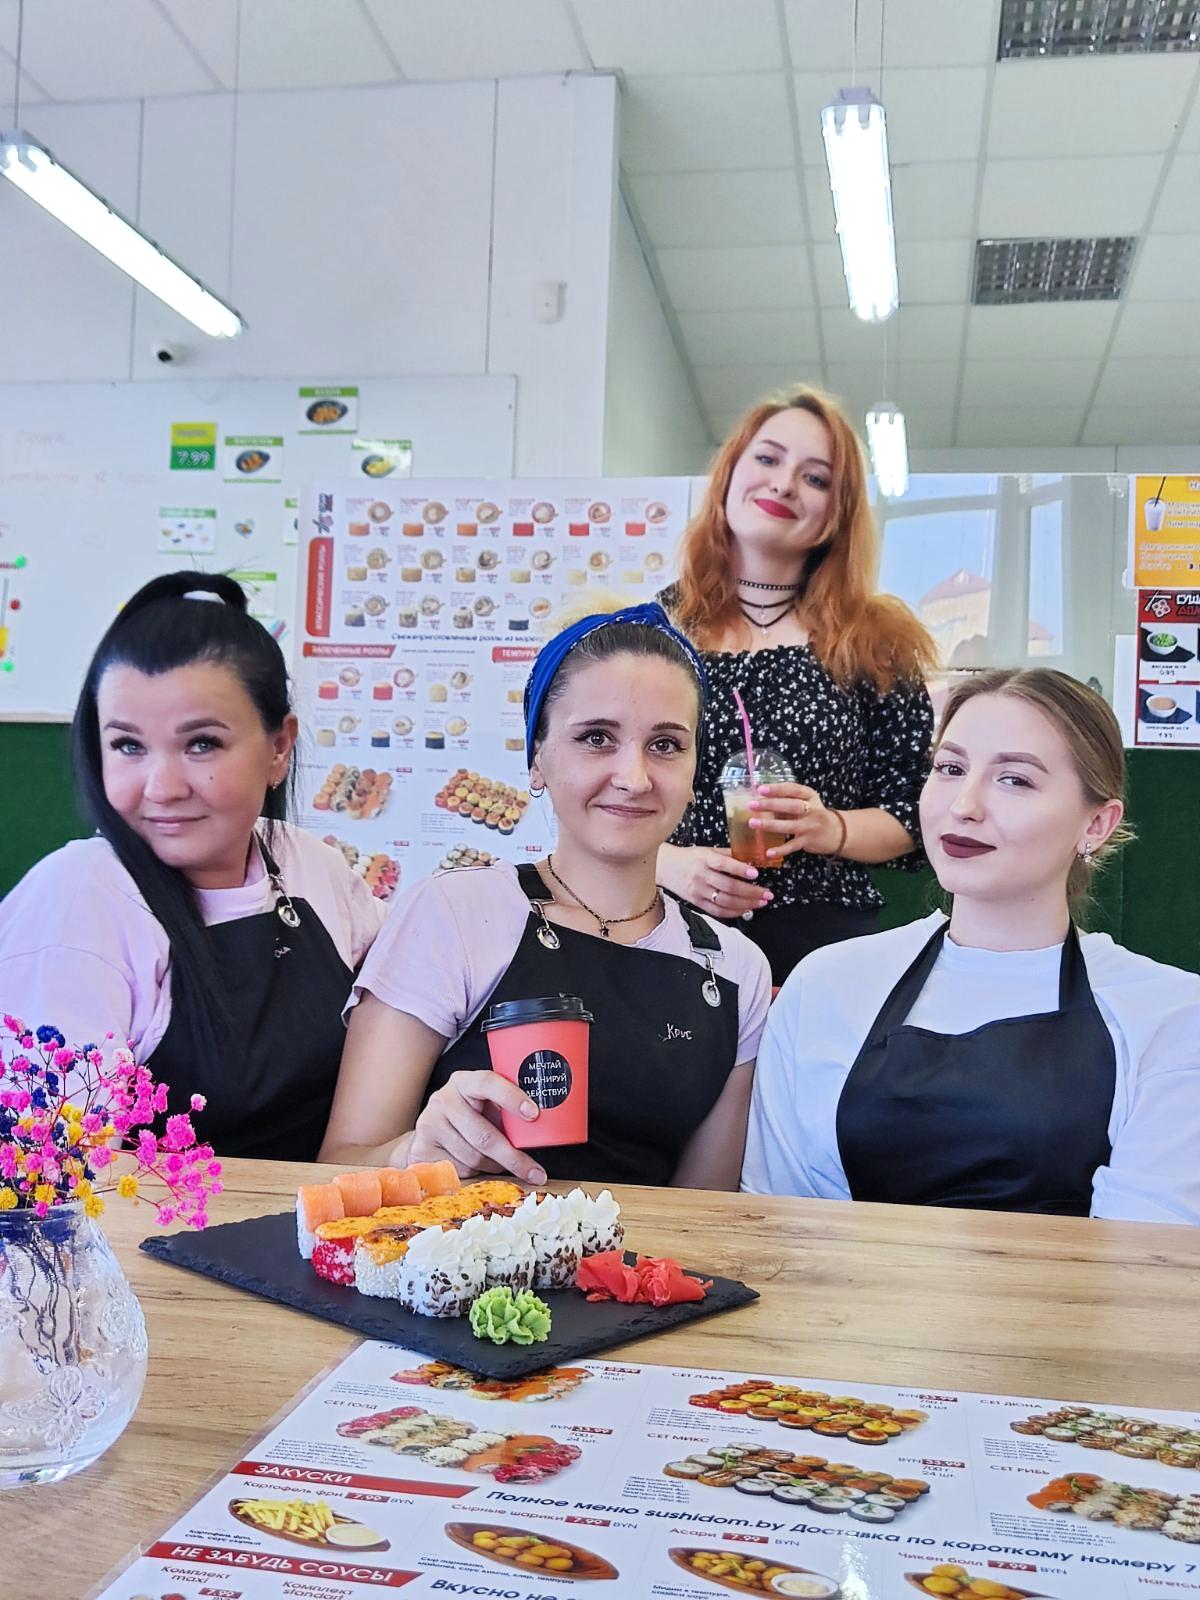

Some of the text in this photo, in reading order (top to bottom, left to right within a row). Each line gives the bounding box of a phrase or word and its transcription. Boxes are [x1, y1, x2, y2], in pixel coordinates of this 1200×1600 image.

[528, 1059, 562, 1070] МЕЧТАЙ
[524, 1072, 567, 1084] ПЛАНИРУЙ
[693, 1373, 725, 1381] ЛАВА
[254, 1464, 353, 1484] ЗАКУСКИ
[243, 1481, 312, 1495] Картофель
[316, 1489, 343, 1497] фри
[353, 1493, 383, 1501] 7.99
[451, 1503, 638, 1529] Сырные шарики 7.99 BYN
[486, 1491, 1197, 1573] Полное меню sushidom.by Доставка по короткому номеру 7
[669, 1527, 800, 1546] Асари 7.99 BYN
[161, 1565, 232, 1580] Комплект
[170, 1545, 394, 1582] НЕ ЗАБУДЬ СОУСЫ
[898, 1551, 1068, 1575] Чикен болл 7.99 BYN
[171, 1574, 209, 1584] maxi
[282, 1581, 355, 1595] Комплект
[430, 1579, 521, 1598] Вкусно
[282, 1588, 344, 1600] standart
